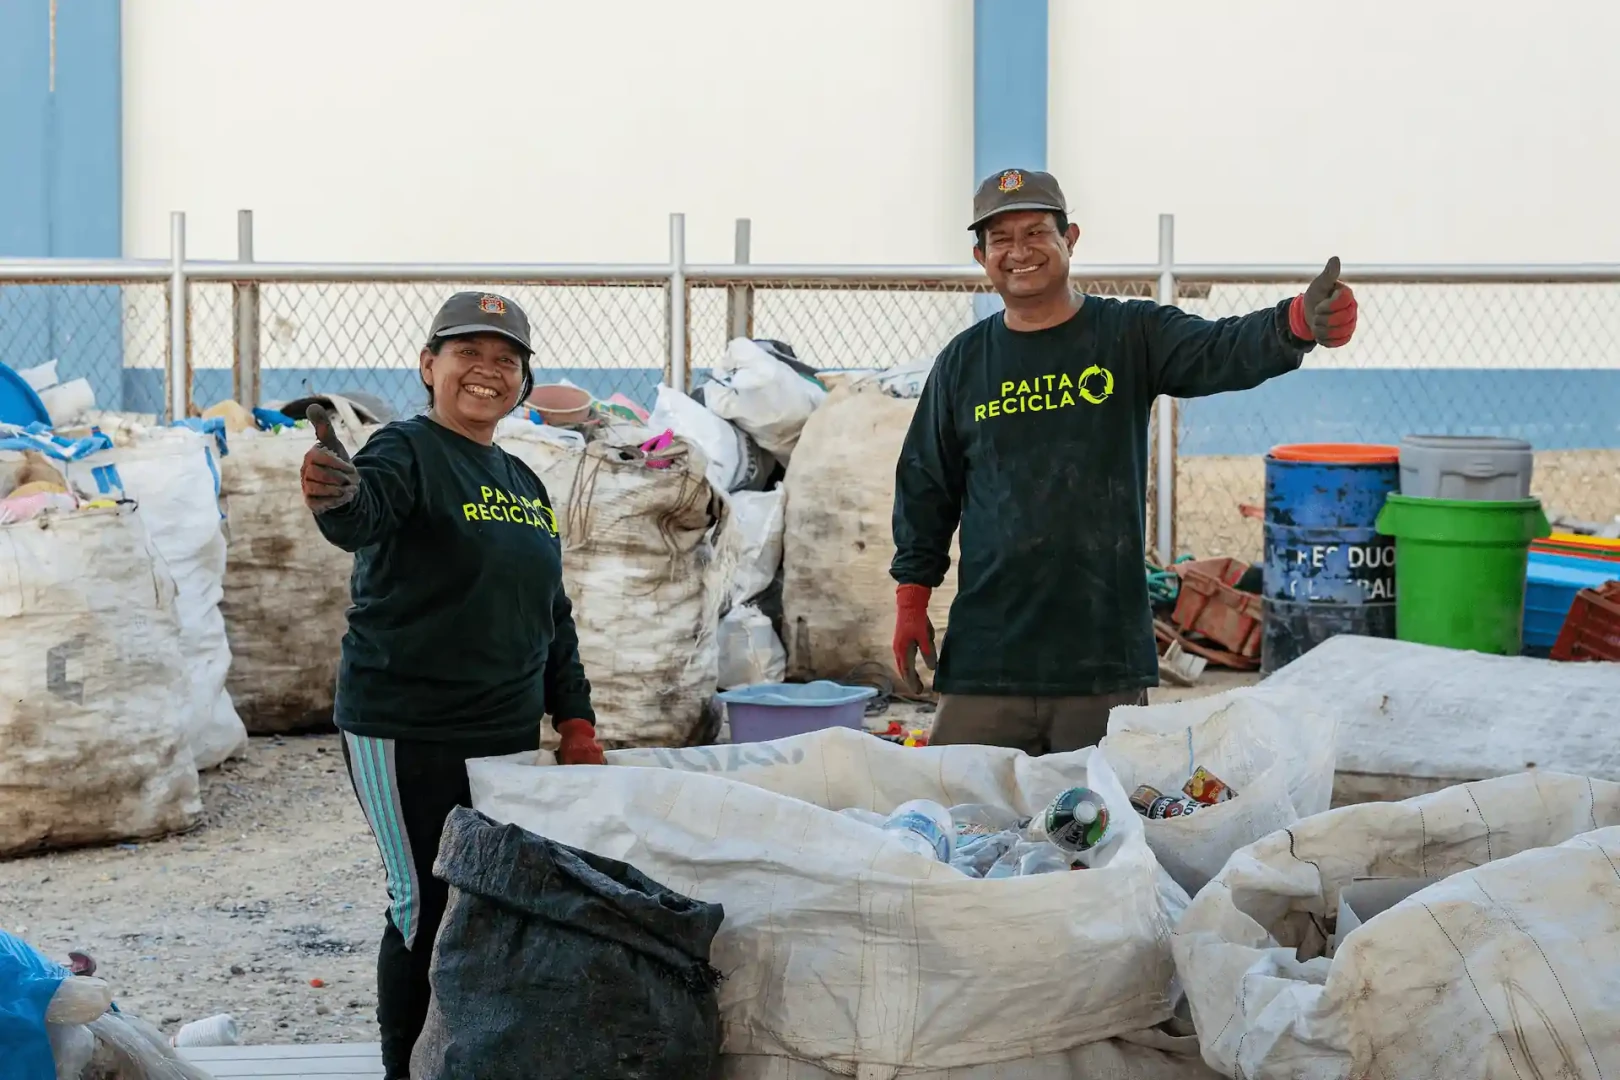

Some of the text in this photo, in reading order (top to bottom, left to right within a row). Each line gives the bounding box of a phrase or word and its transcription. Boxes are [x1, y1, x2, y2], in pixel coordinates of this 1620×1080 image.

[1001, 373, 1074, 397] PAITA
[974, 390, 1076, 422] RECICLA
[462, 503, 544, 530] RECICLA
